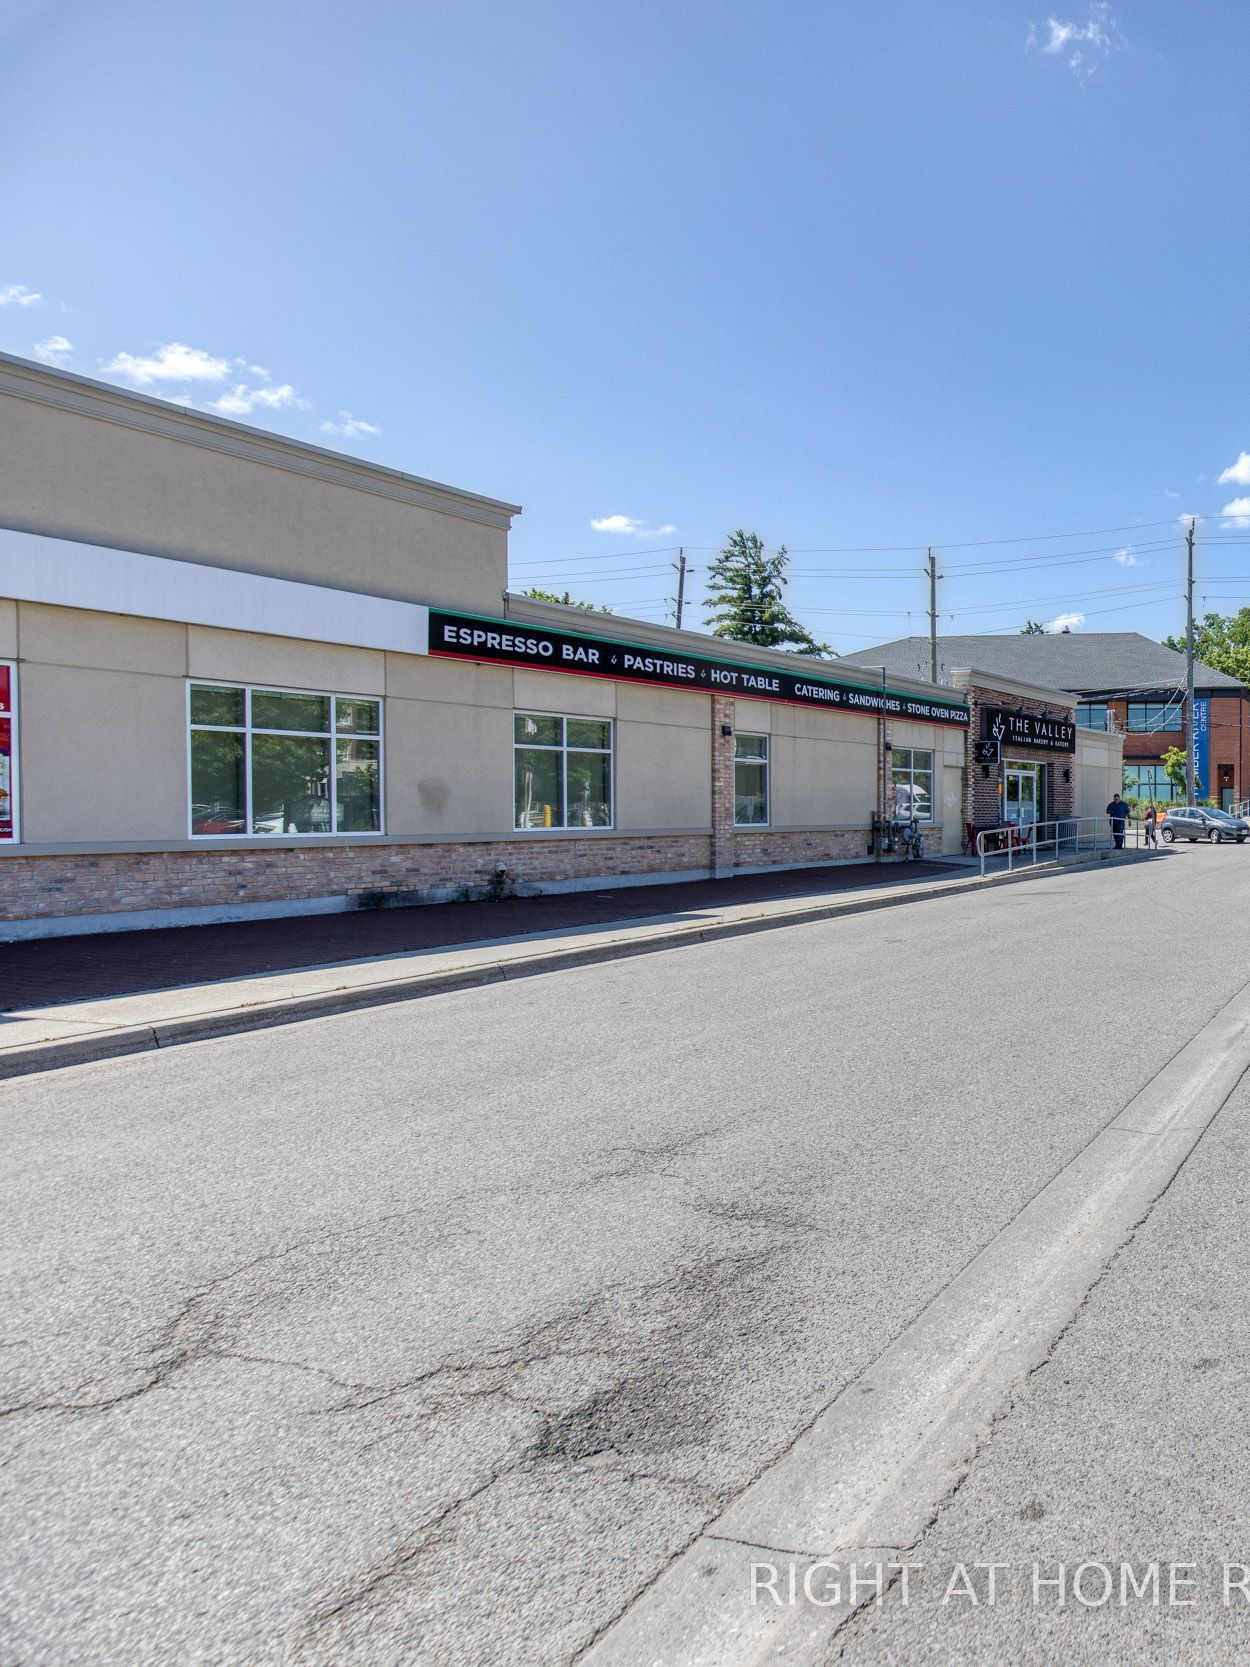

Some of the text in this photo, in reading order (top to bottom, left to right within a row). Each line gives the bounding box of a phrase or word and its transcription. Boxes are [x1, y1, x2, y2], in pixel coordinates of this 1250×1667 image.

[444, 625, 780, 691] ESPRESSO BAR PASTRIES HOT TABLE
[795, 684, 840, 701] CATERING
[907, 703, 930, 716] STONE
[931, 707, 949, 719] OVEN
[950, 710, 968, 721] PIZZA
[1009, 717, 1073, 740] THE VALLEY
